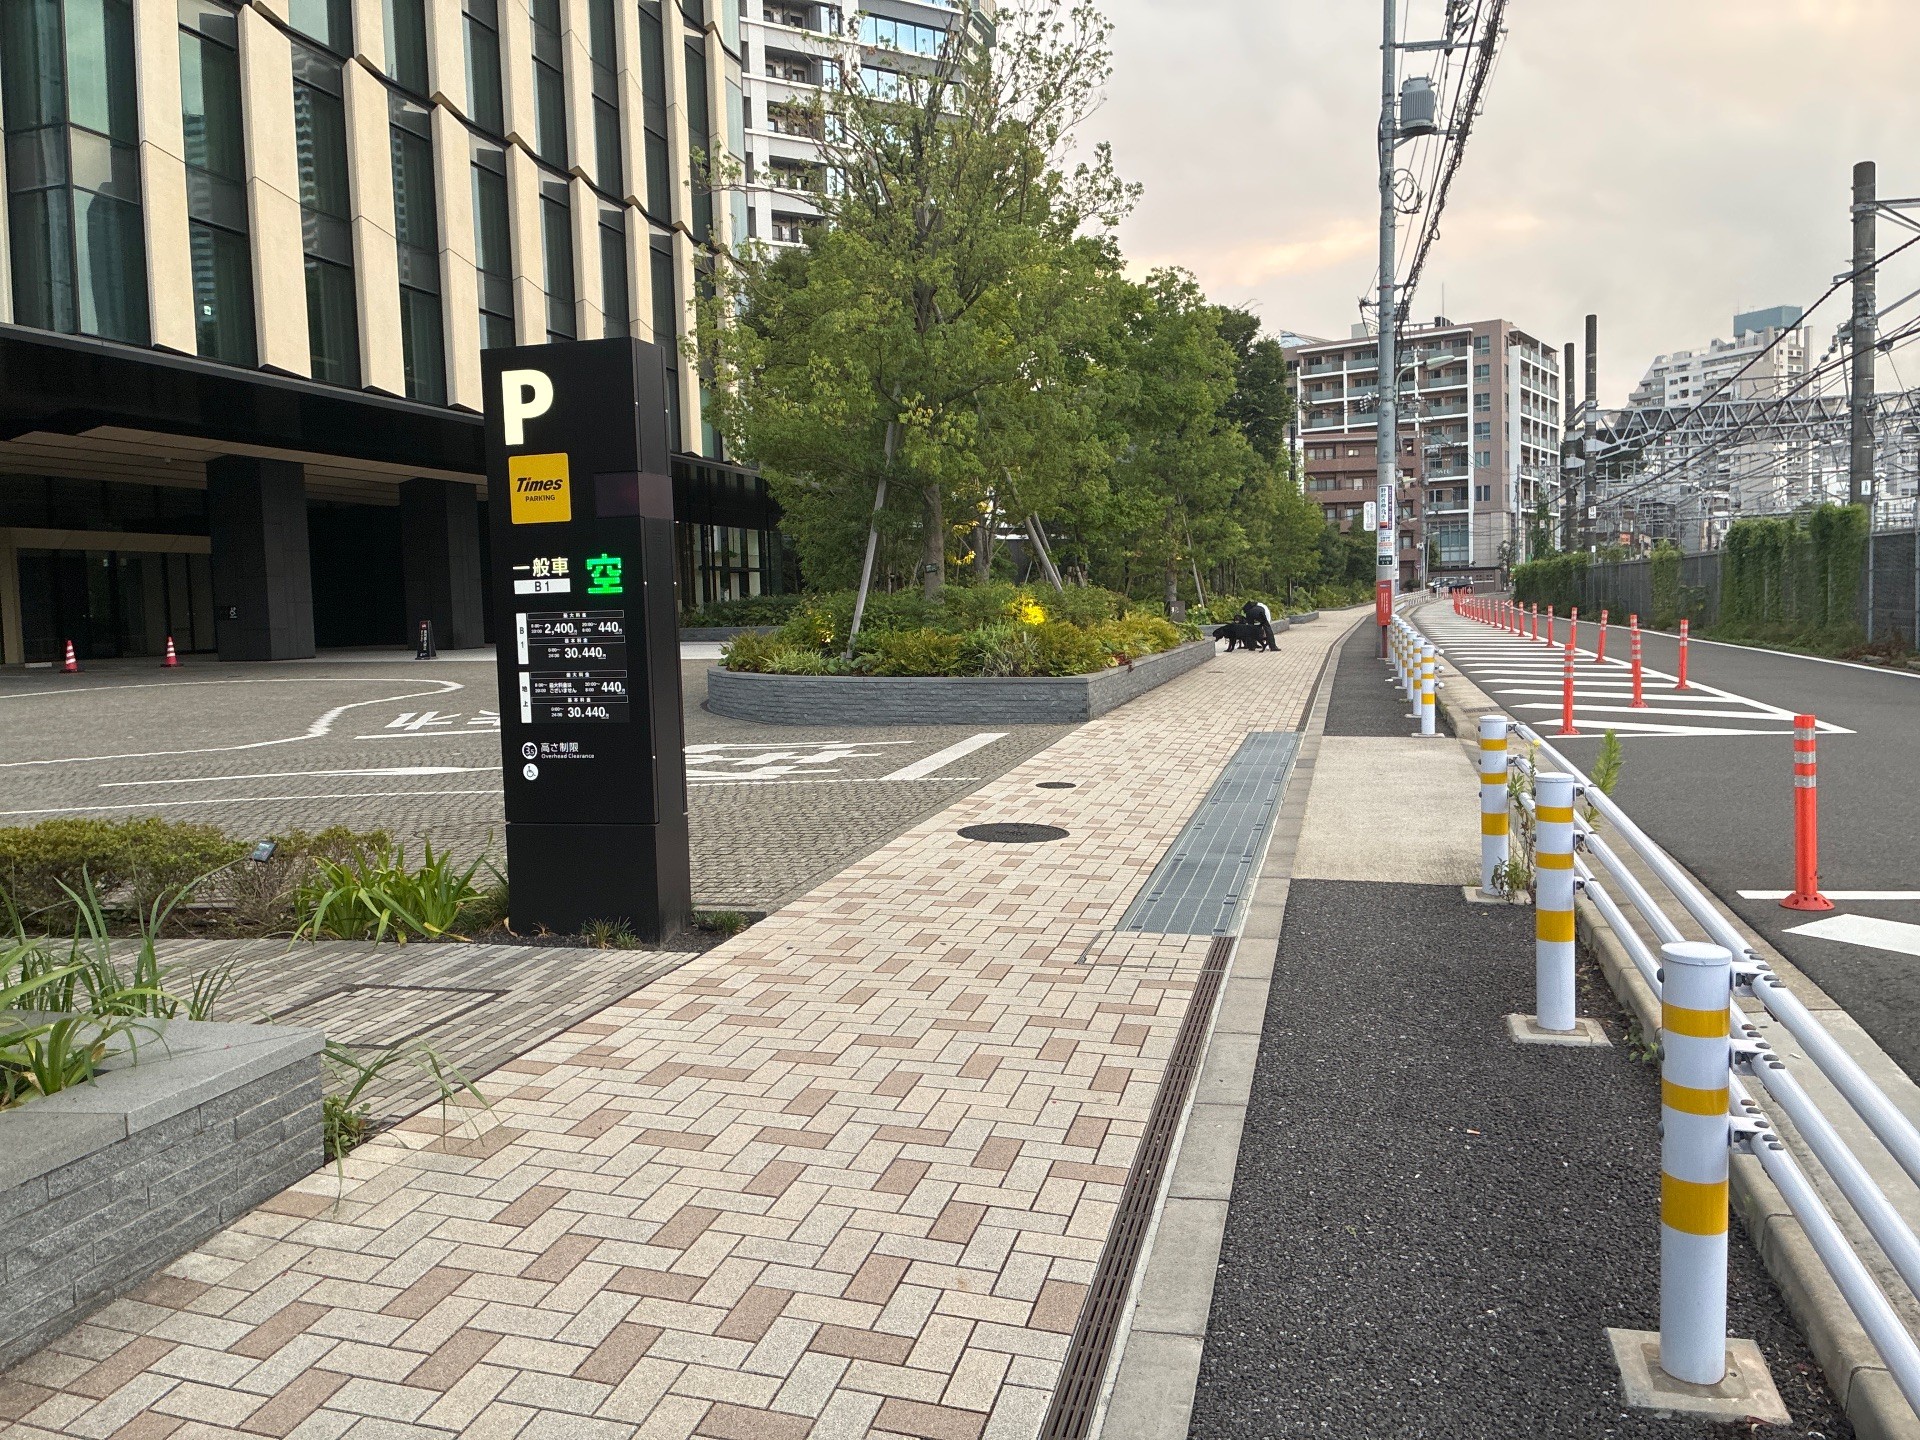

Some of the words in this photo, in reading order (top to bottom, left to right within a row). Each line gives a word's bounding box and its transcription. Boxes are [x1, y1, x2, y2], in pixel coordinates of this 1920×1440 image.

[501, 369, 554, 446] P
[516, 477, 563, 492] Times
[525, 494, 556, 502] PARKING
[512, 556, 570, 577] 一般車
[586, 553, 623, 594] 空
[534, 581, 550, 592] B1
[540, 742, 579, 753] 高さ制限
